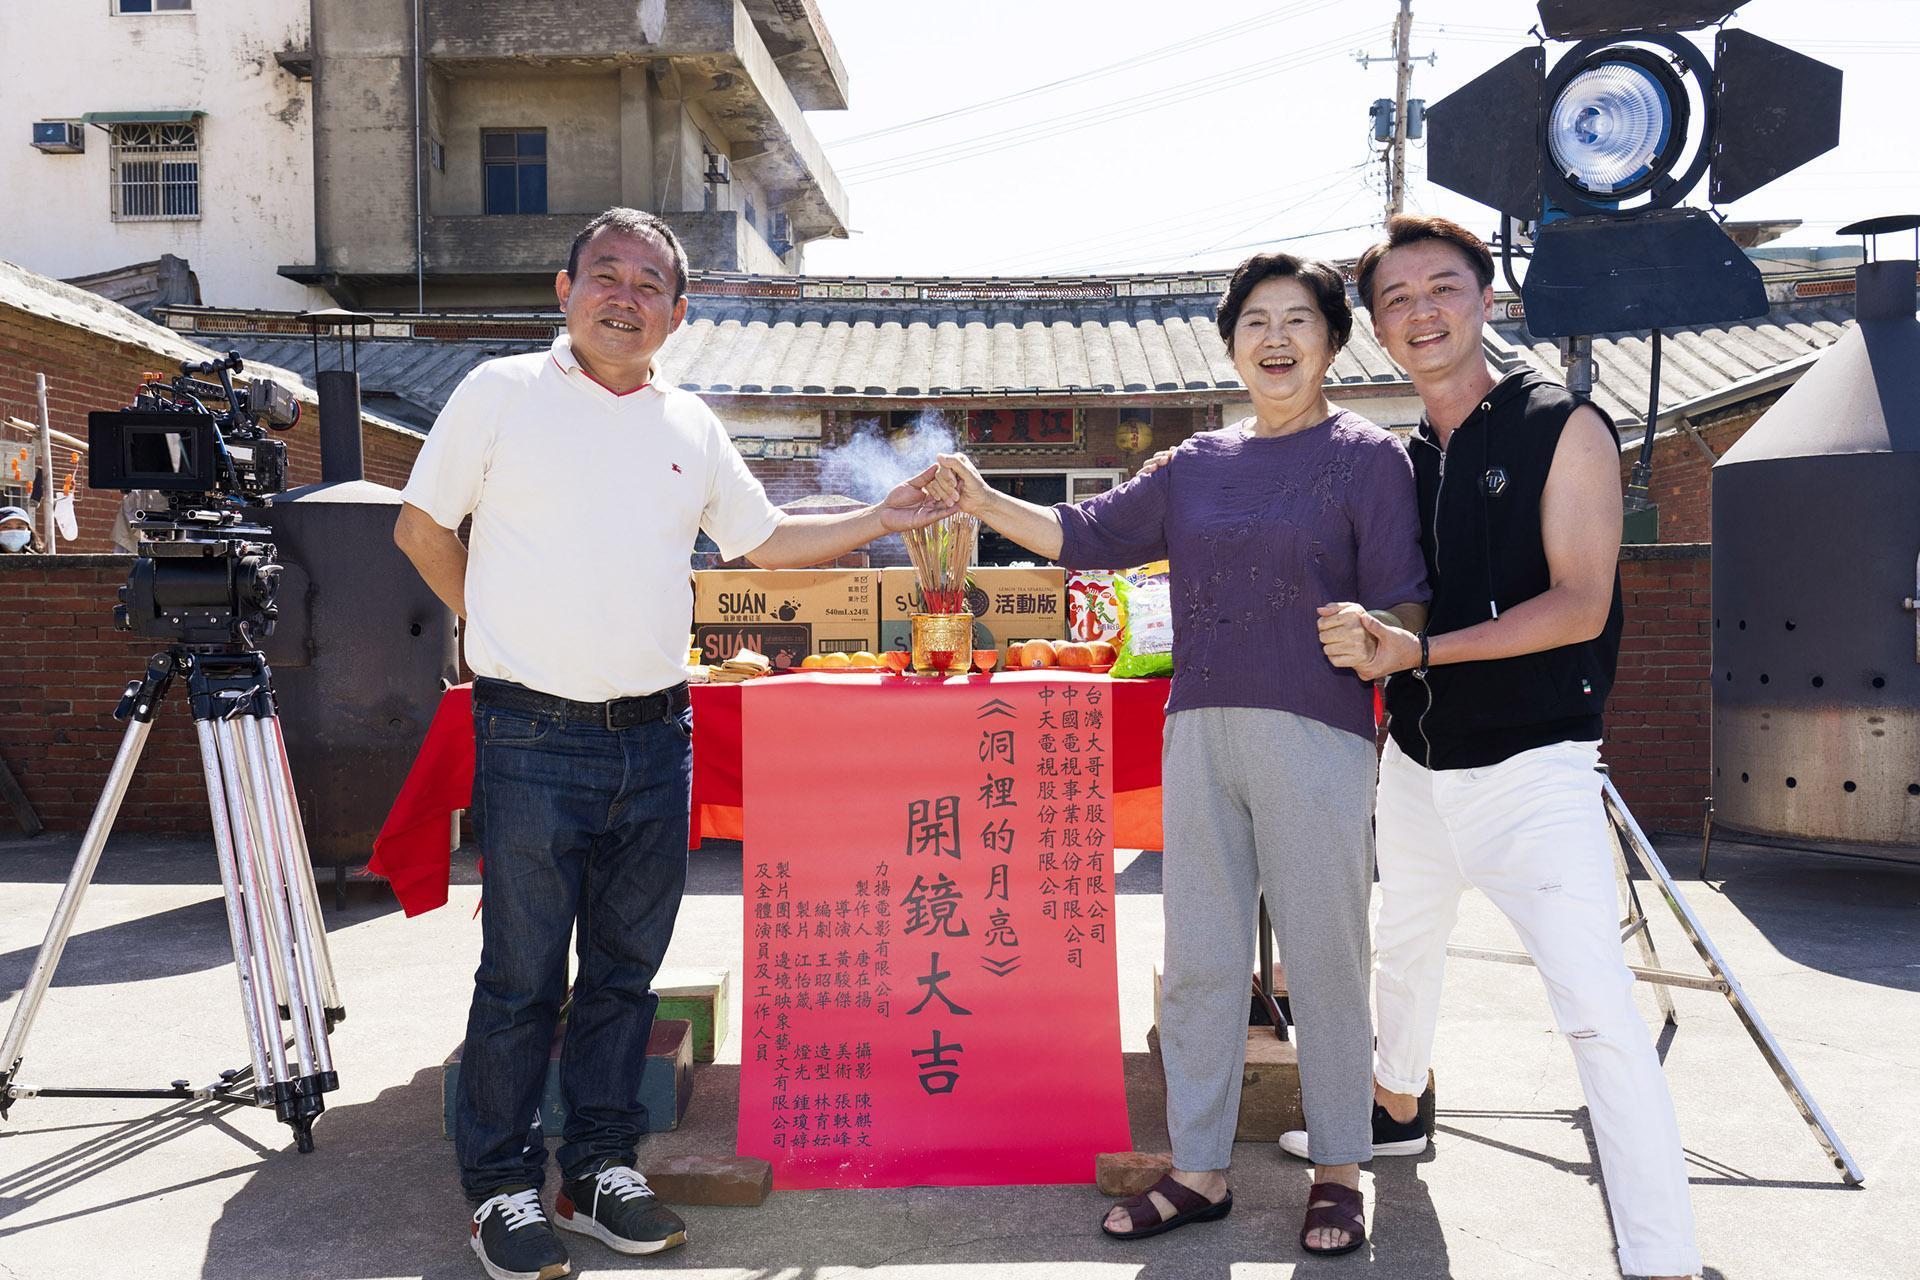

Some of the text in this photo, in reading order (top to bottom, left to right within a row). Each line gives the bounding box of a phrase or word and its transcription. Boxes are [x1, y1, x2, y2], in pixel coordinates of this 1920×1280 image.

[718, 589, 766, 614] SUÁN
[995, 594, 1057, 614] 活動版
[977, 698, 1021, 978] 《洞裡的月亮》
[1036, 685, 1061, 921] 中天電視股份有限公司
[1060, 685, 1086, 969] 中國電視事業股份有限公司
[1084, 685, 1109, 944] 台灣大哥大股份有限公司
[775, 861, 792, 939] 製片團隊
[795, 900, 812, 939] 製片
[814, 901, 831, 939] 編劇
[834, 900, 852, 939] 導演
[854, 879, 872, 1008] 製作人 唐在揚
[874, 861, 892, 1018] 力揚電影有限公司
[900, 795, 973, 1096] 開鏡大吉
[754, 862, 773, 1062] 及全體演員及工作人員
[793, 1042, 812, 1081] 燈光
[814, 1042, 832, 1080] 造型
[834, 1042, 852, 1080] 美術
[855, 1042, 873, 1147] 攝影 陳麒文
